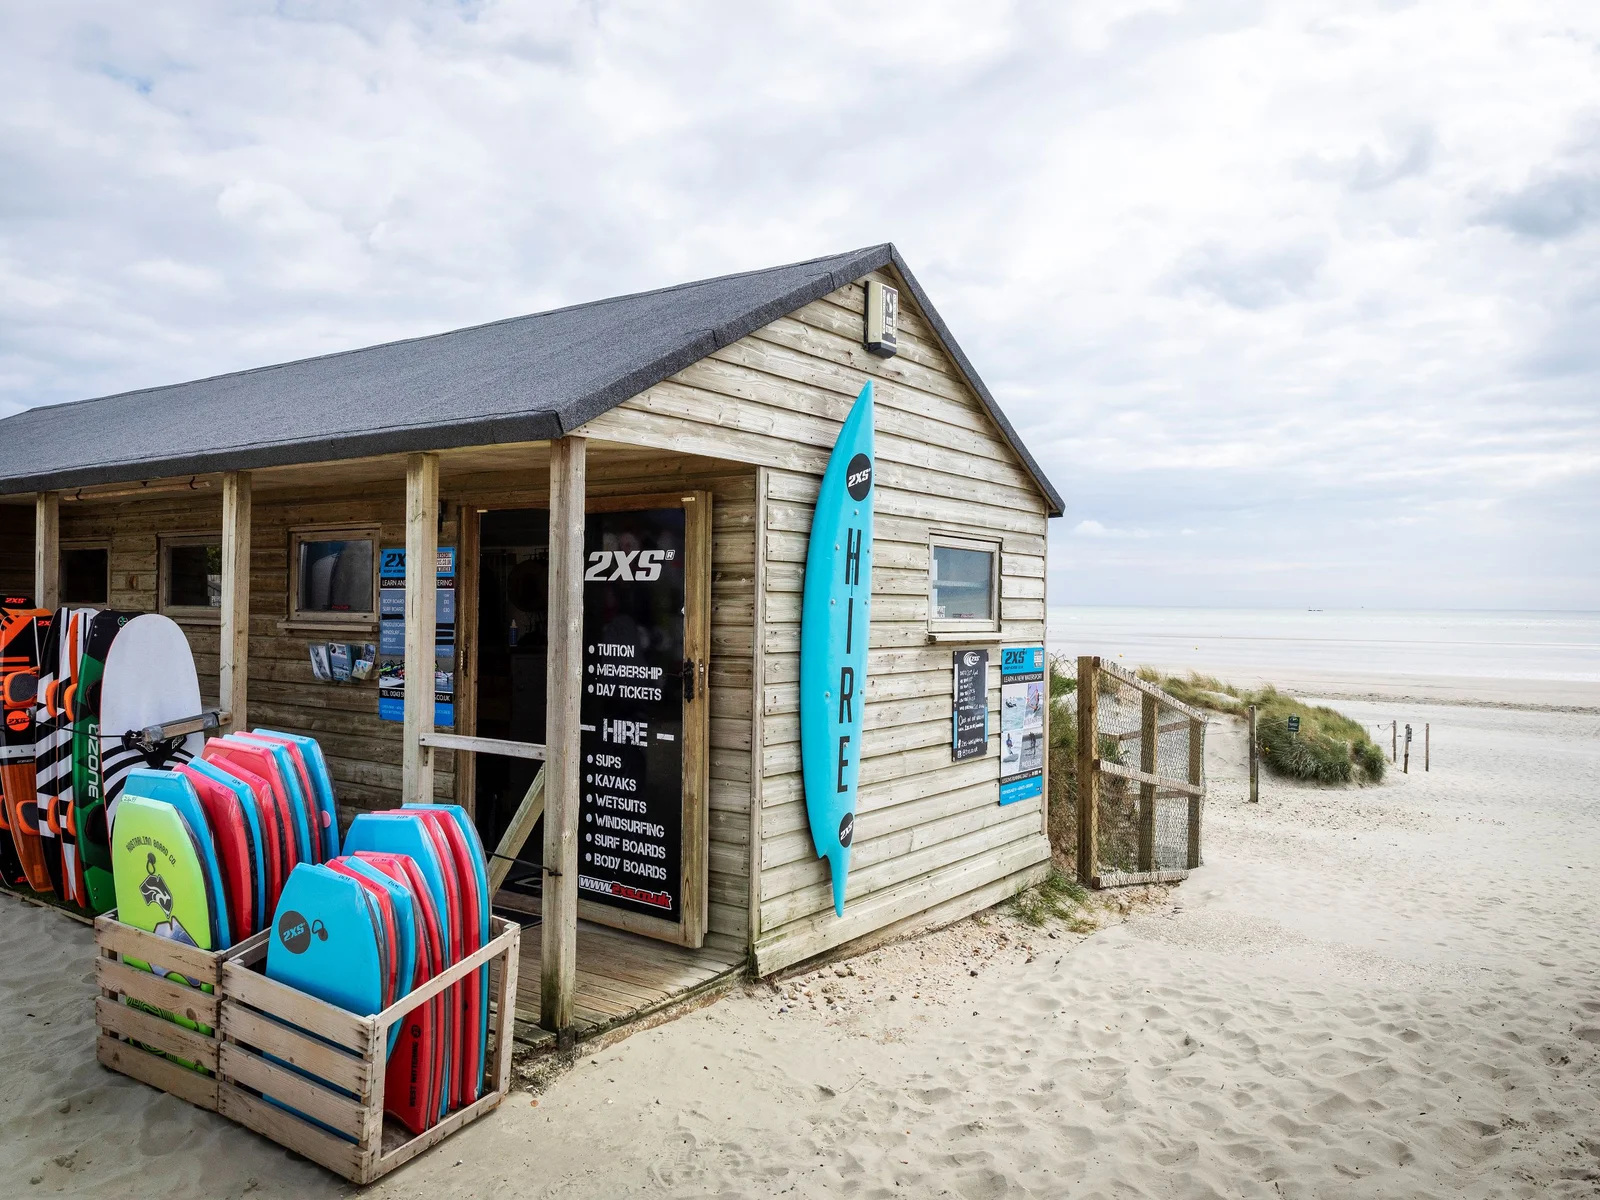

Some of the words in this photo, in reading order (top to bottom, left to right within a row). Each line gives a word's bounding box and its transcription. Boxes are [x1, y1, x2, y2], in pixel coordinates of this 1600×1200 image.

[384, 553, 406, 568] 2X
[437, 579, 452, 587] ERING
[597, 643, 635, 658] TUITION
[838, 527, 862, 793] HIRE
[596, 663, 663, 680] MEMBERSHIP
[596, 683, 616, 697] DAY
[618, 685, 662, 701] TICKETS
[602, 718, 648, 747] HIRE
[595, 753, 622, 769] SUPS
[595, 773, 637, 792] KAYAKS
[595, 793, 647, 814] WETSUITS
[595, 813, 665, 838] WINDSURFING
[125, 835, 153, 854] AUSTRALIAN
[153, 839, 169, 857] BOARD
[594, 833, 620, 850] SURF
[622, 839, 666, 860] BOARDS
[594, 853, 621, 870] BODY
[623, 859, 667, 881] BOARDS
[282, 922, 306, 942] 2XS
